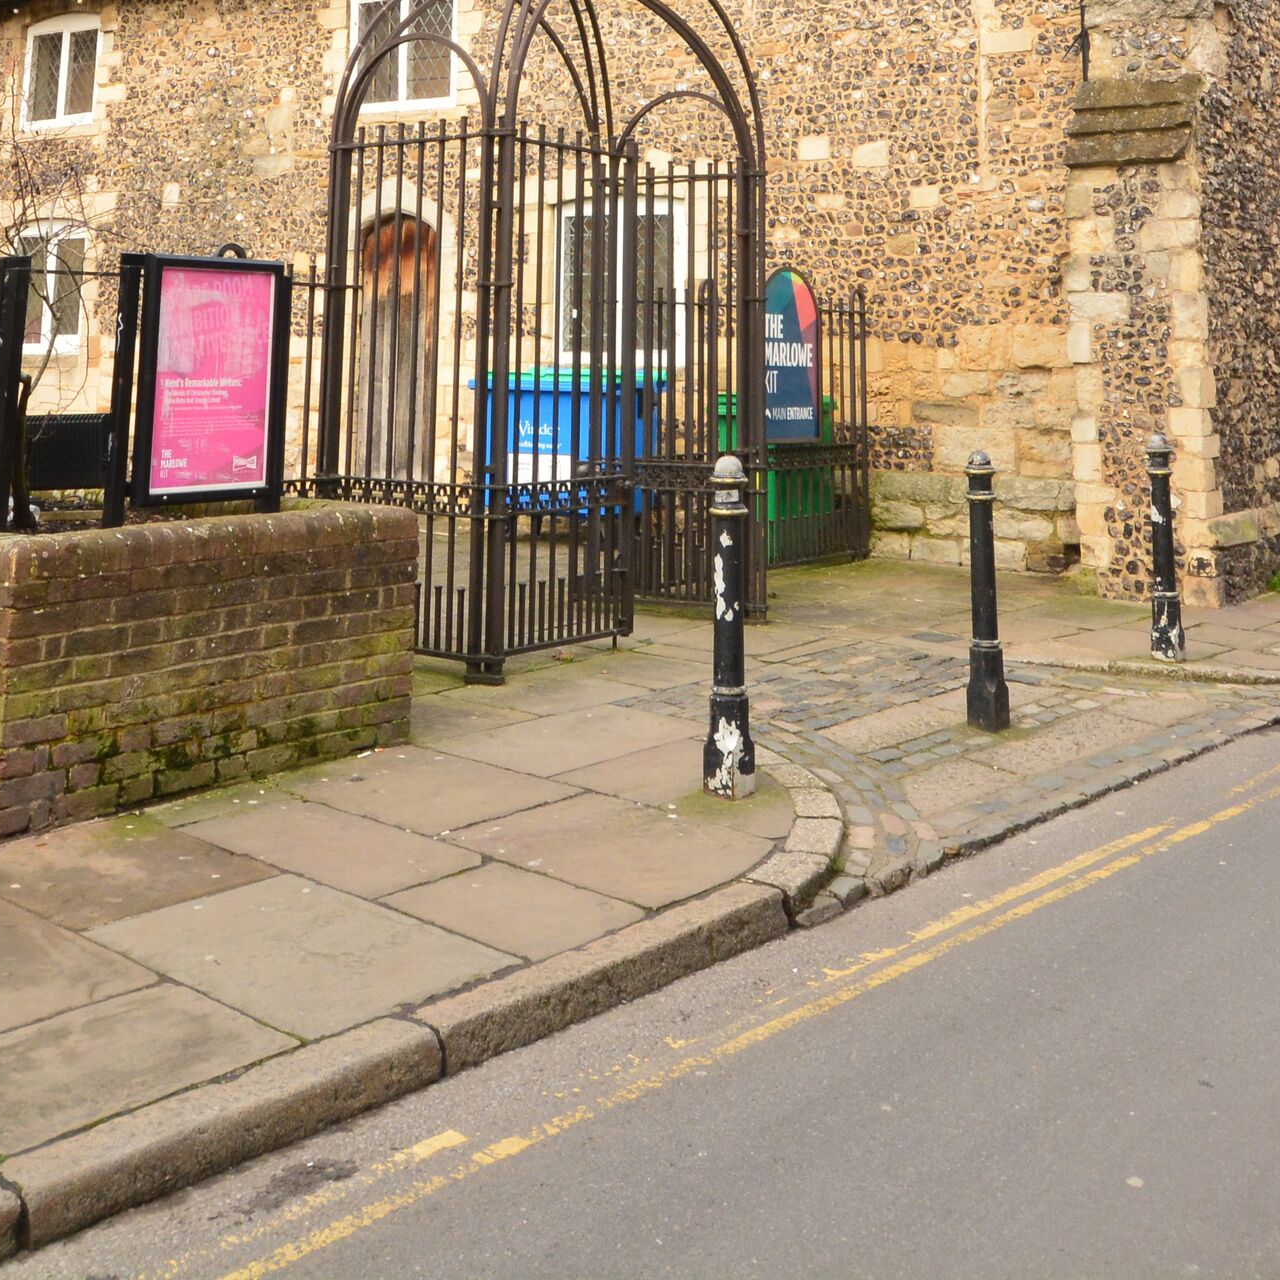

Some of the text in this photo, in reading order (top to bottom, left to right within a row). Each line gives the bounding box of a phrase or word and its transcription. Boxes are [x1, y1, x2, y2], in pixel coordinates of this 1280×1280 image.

[765, 313, 784, 339] THE
[765, 341, 813, 368] MARLOWE
[185, 377, 219, 387] Remarkable
[772, 406, 814, 421] MAIN ENTRANCE
[161, 449, 173, 459] THE
[160, 458, 188, 469] MARLOWE
[160, 469, 168, 478] KIT
